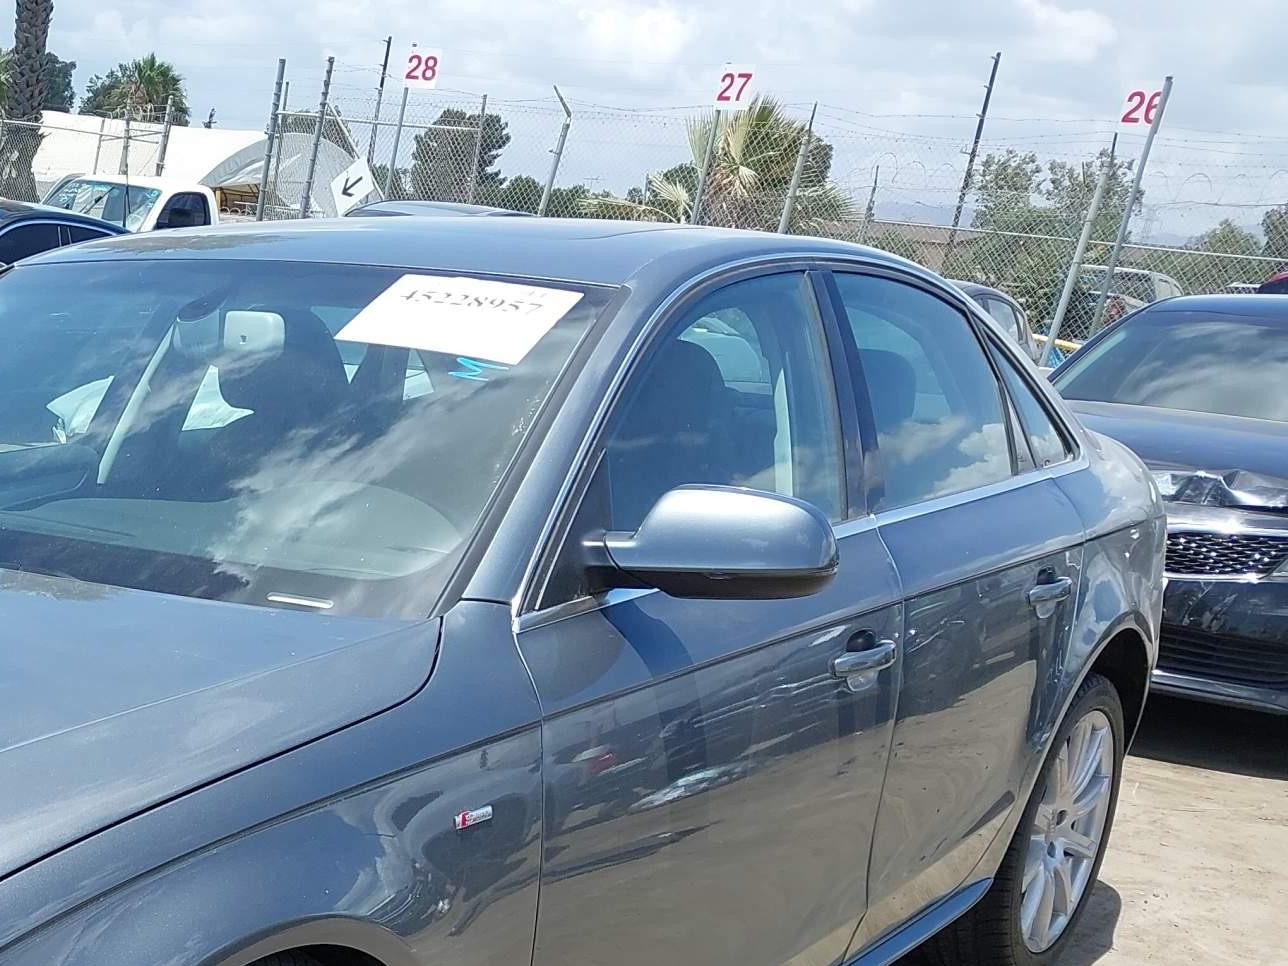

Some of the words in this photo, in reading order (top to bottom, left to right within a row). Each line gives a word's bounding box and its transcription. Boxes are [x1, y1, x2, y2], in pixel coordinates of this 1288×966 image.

[405, 54, 438, 81] 28
[716, 72, 753, 102] 27
[400, 289, 544, 315] 45228957
